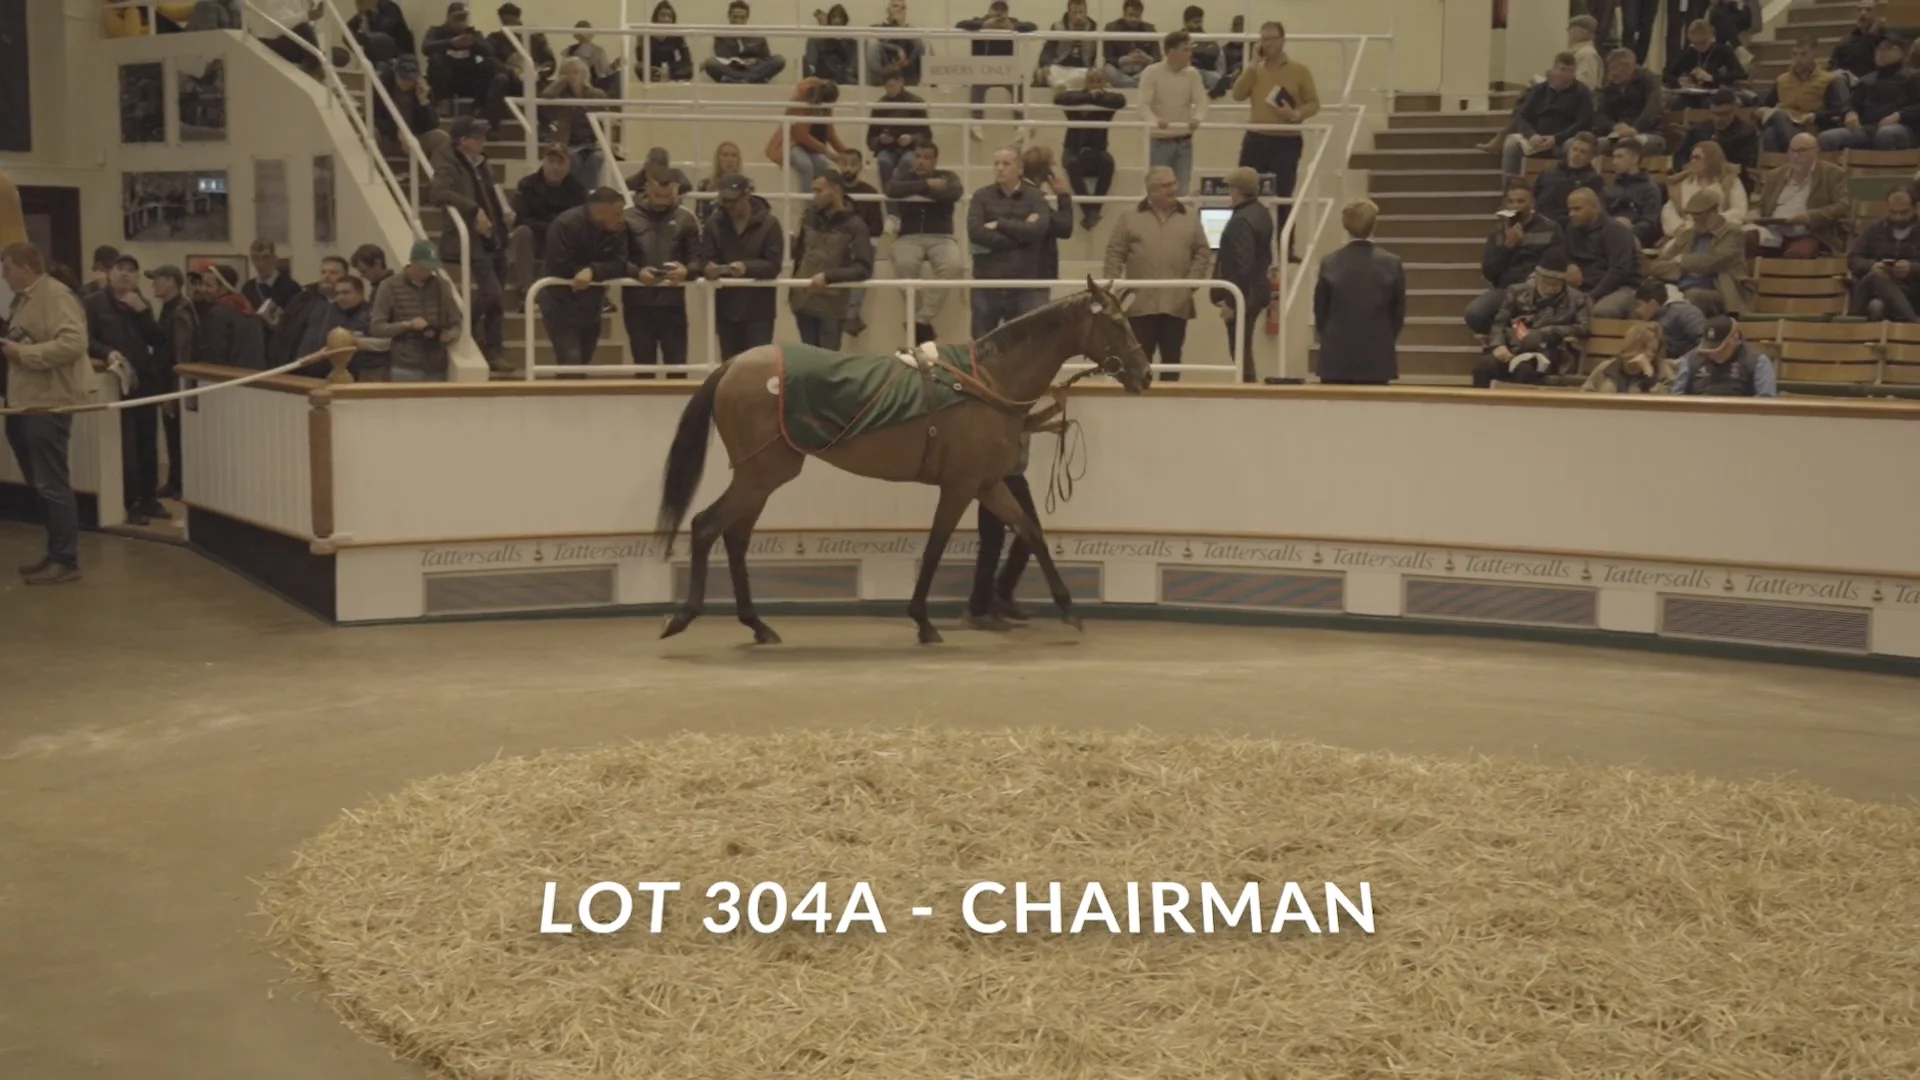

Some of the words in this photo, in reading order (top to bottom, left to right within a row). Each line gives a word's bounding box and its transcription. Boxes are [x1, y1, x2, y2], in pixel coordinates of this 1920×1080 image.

[981, 64, 1013, 76] ONLY
[420, 544, 523, 567] Tattersalls
[552, 538, 655, 561] Tattersalls
[817, 535, 916, 555] Tattersalls
[1073, 538, 1173, 558] Tattersalls
[1203, 541, 1303, 562] Tattersalls
[1332, 547, 1434, 570] Tattersalls
[1465, 554, 1570, 578] Tattersalls
[1603, 564, 1712, 589] Tattersalls
[1745, 573, 1860, 600] Tattersalls
